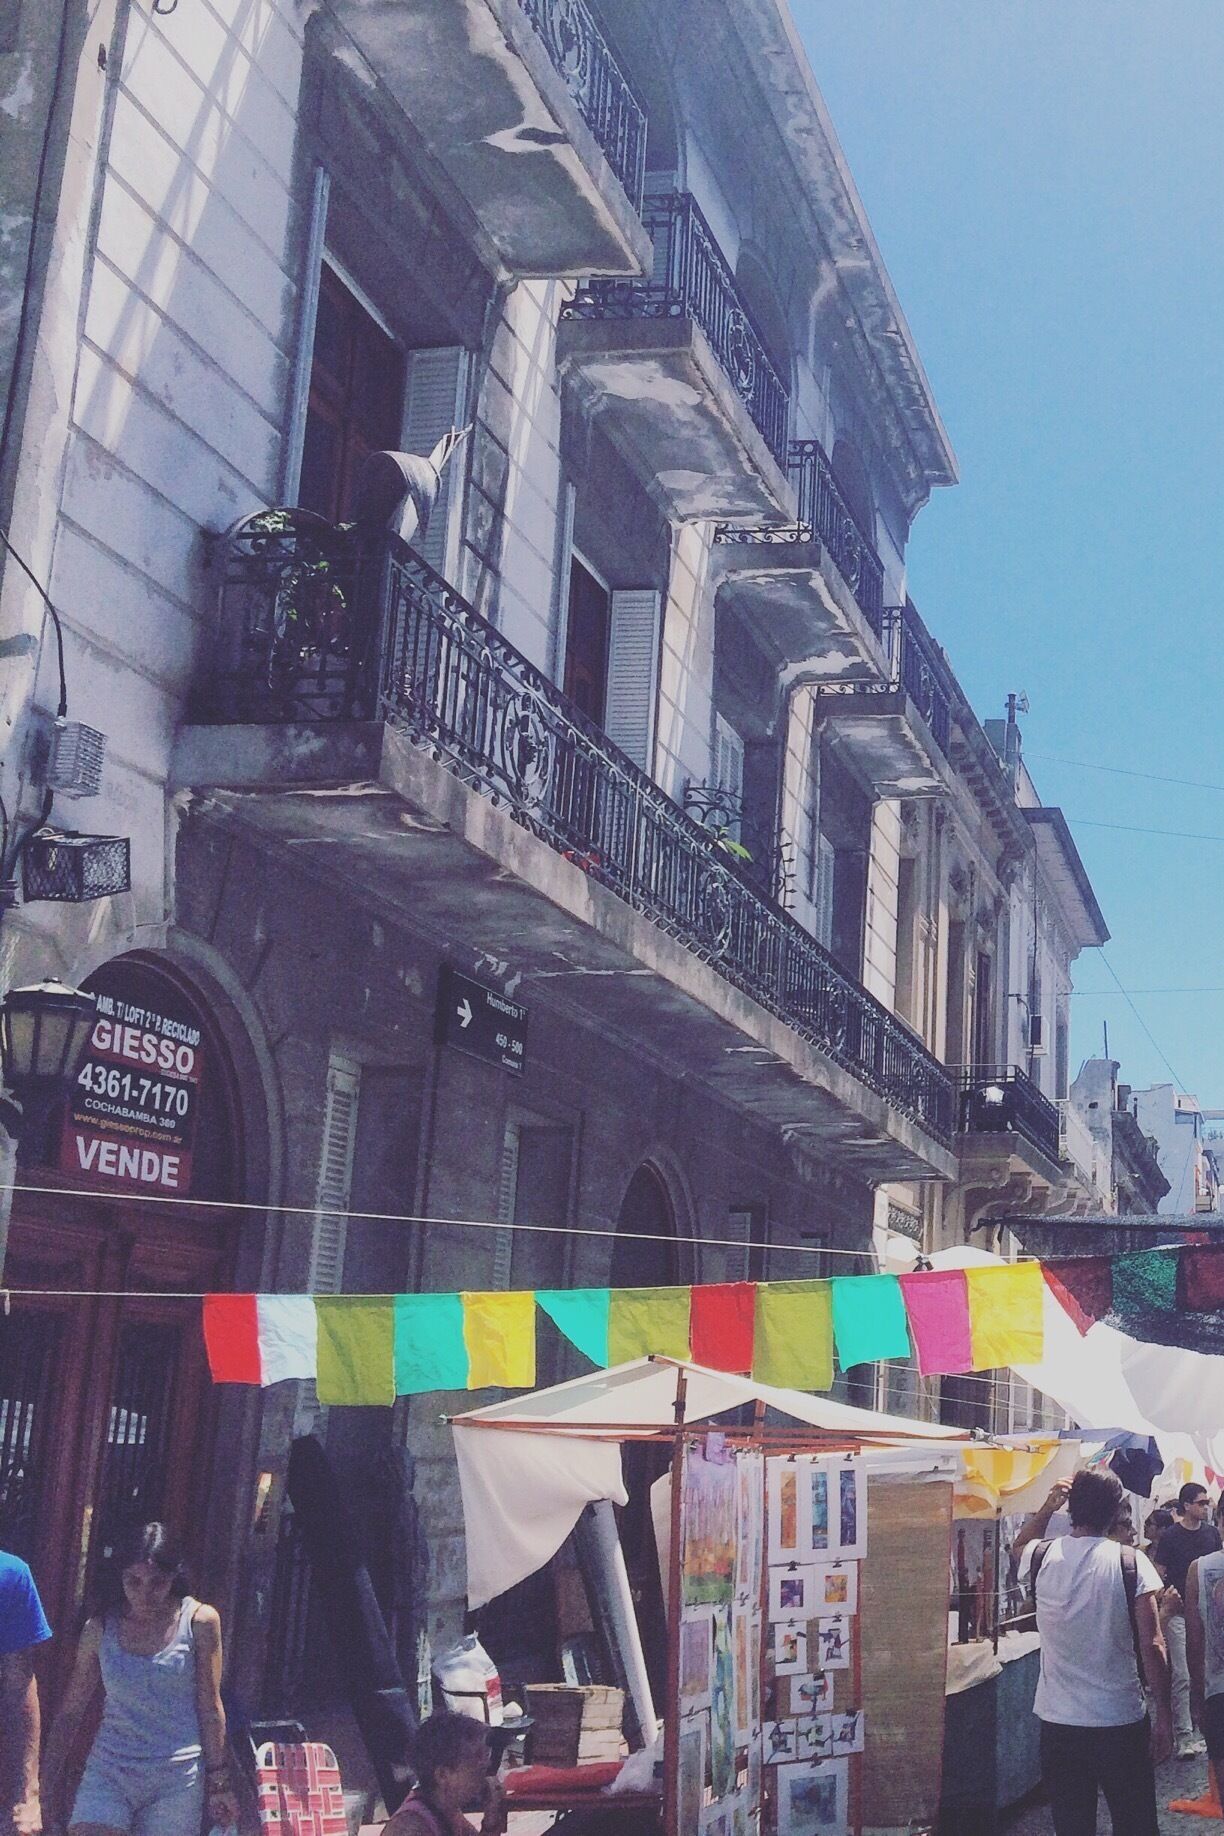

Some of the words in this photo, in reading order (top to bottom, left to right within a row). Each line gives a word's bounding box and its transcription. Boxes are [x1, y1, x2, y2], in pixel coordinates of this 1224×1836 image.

[486, 991, 518, 1019] Humberto
[91, 1018, 194, 1074] GIESSO
[161, 1018, 201, 1046] RECICLADO
[77, 1062, 189, 1117] 4361-7170
[84, 1098, 158, 1125] COCHABAMBA
[75, 1135, 180, 1187] VENDE
